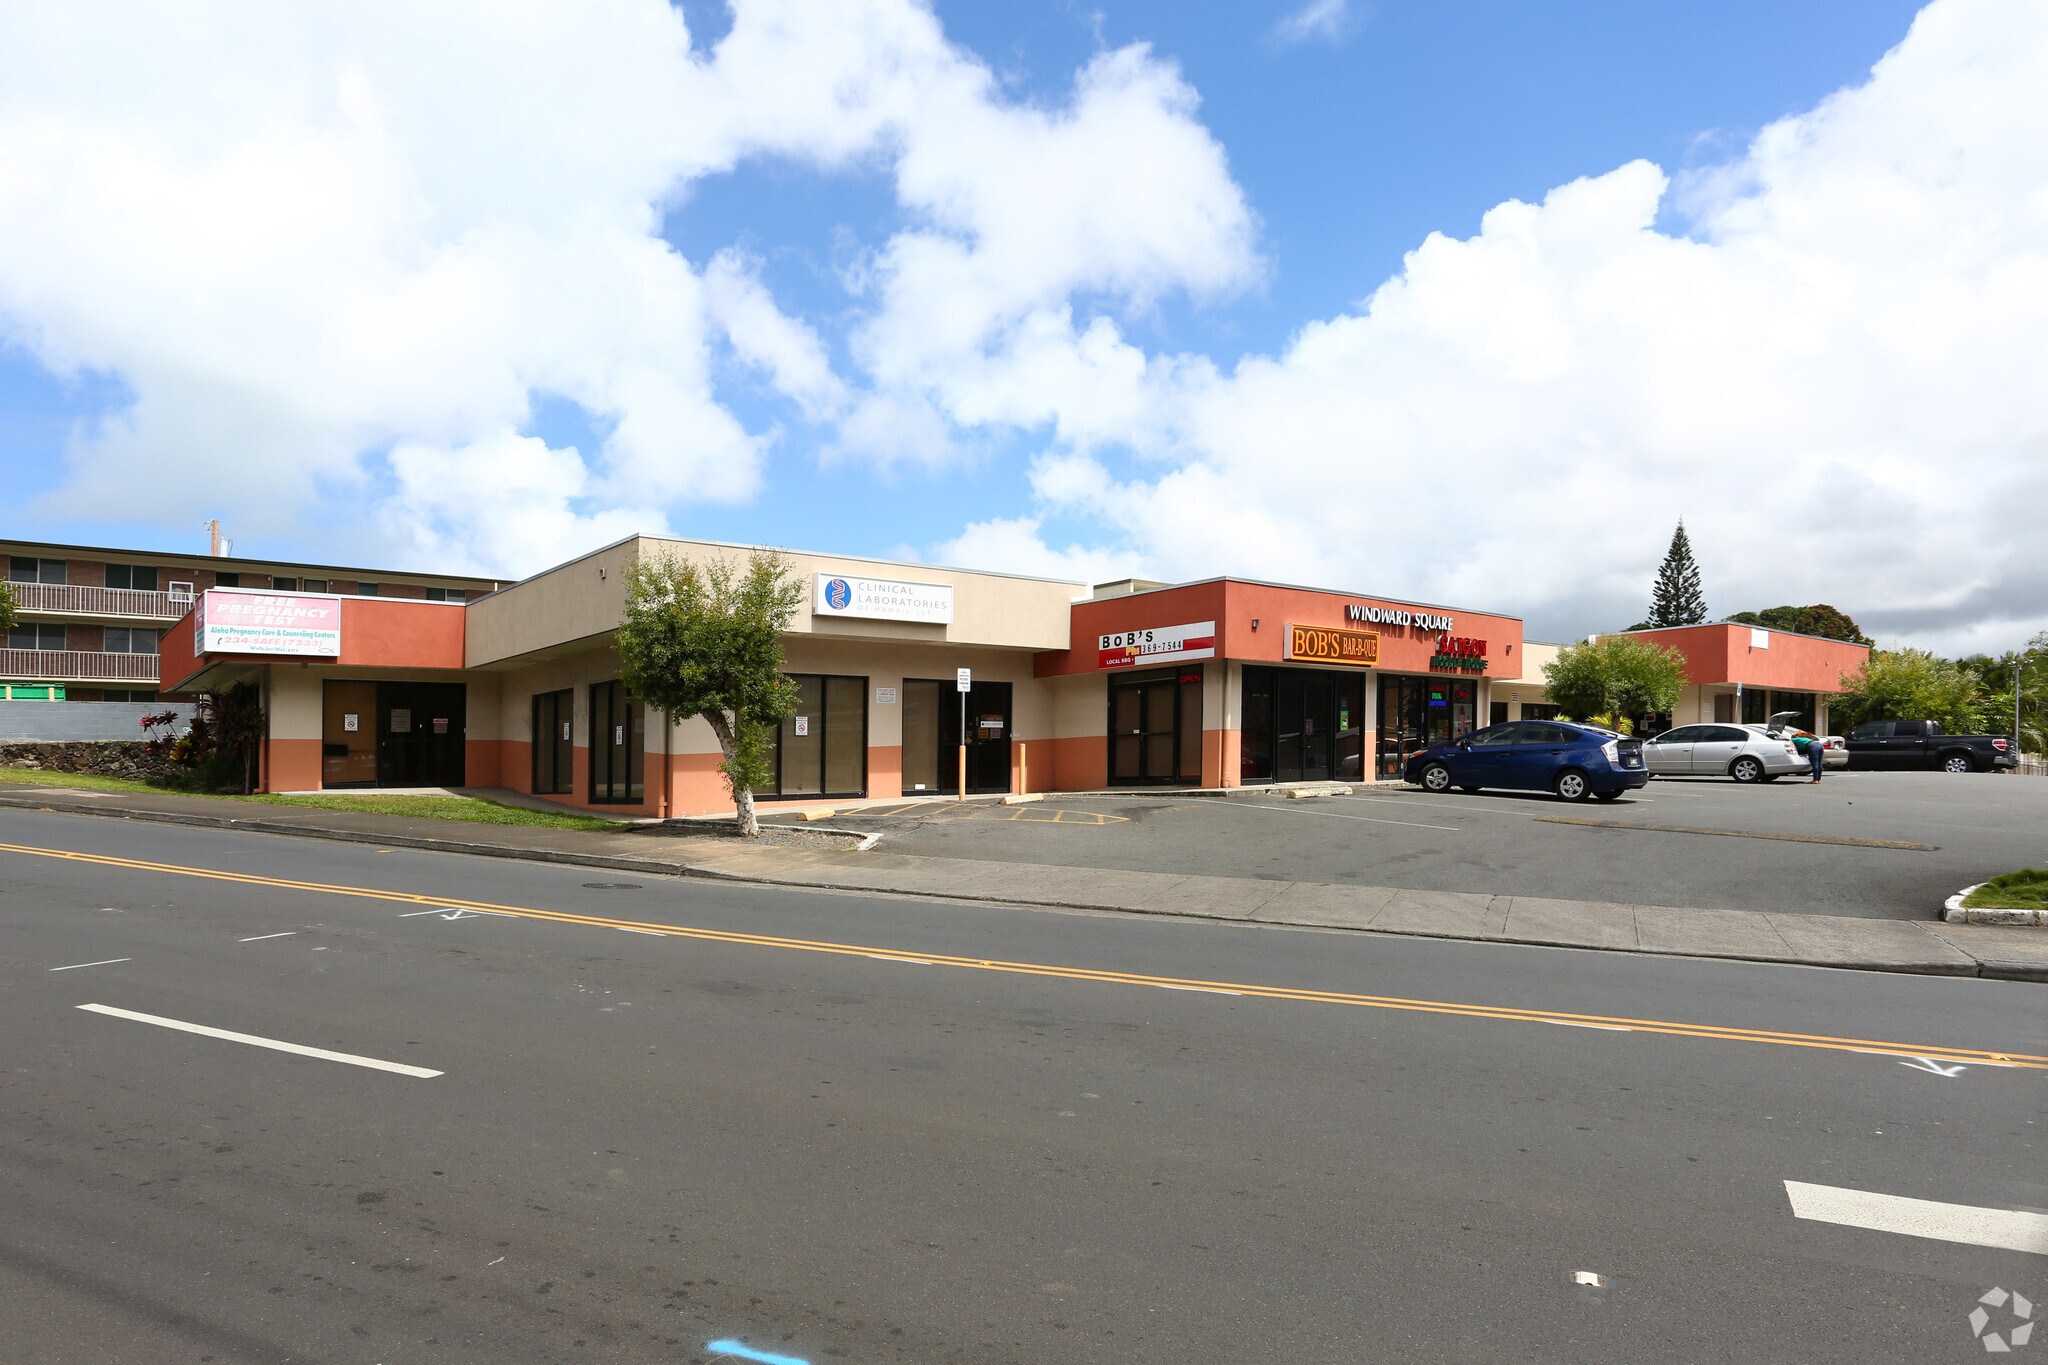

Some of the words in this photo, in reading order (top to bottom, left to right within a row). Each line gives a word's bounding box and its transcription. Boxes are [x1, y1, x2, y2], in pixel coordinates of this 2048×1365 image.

[858, 582, 914, 595] CLINICAL
[252, 595, 297, 607] FREE
[858, 594, 948, 610] LABORATORIES
[216, 603, 331, 619] PREGNANCY
[1349, 604, 1411, 626] WINDWARD
[1414, 612, 1454, 632] SQUARE
[253, 615, 297, 626] TEST
[210, 626, 229, 634] Aloha
[229, 627, 261, 637] Pregnancy
[282, 629, 313, 639] Counseling
[314, 631, 336, 639] Centers
[1142, 640, 1182, 654] 369-7544
[1293, 629, 1340, 658] BOB'S
[1342, 637, 1378, 658] BAR-B-QUE
[1438, 635, 1488, 657] SAIGON
[1179, 674, 1200, 683] OPEN
